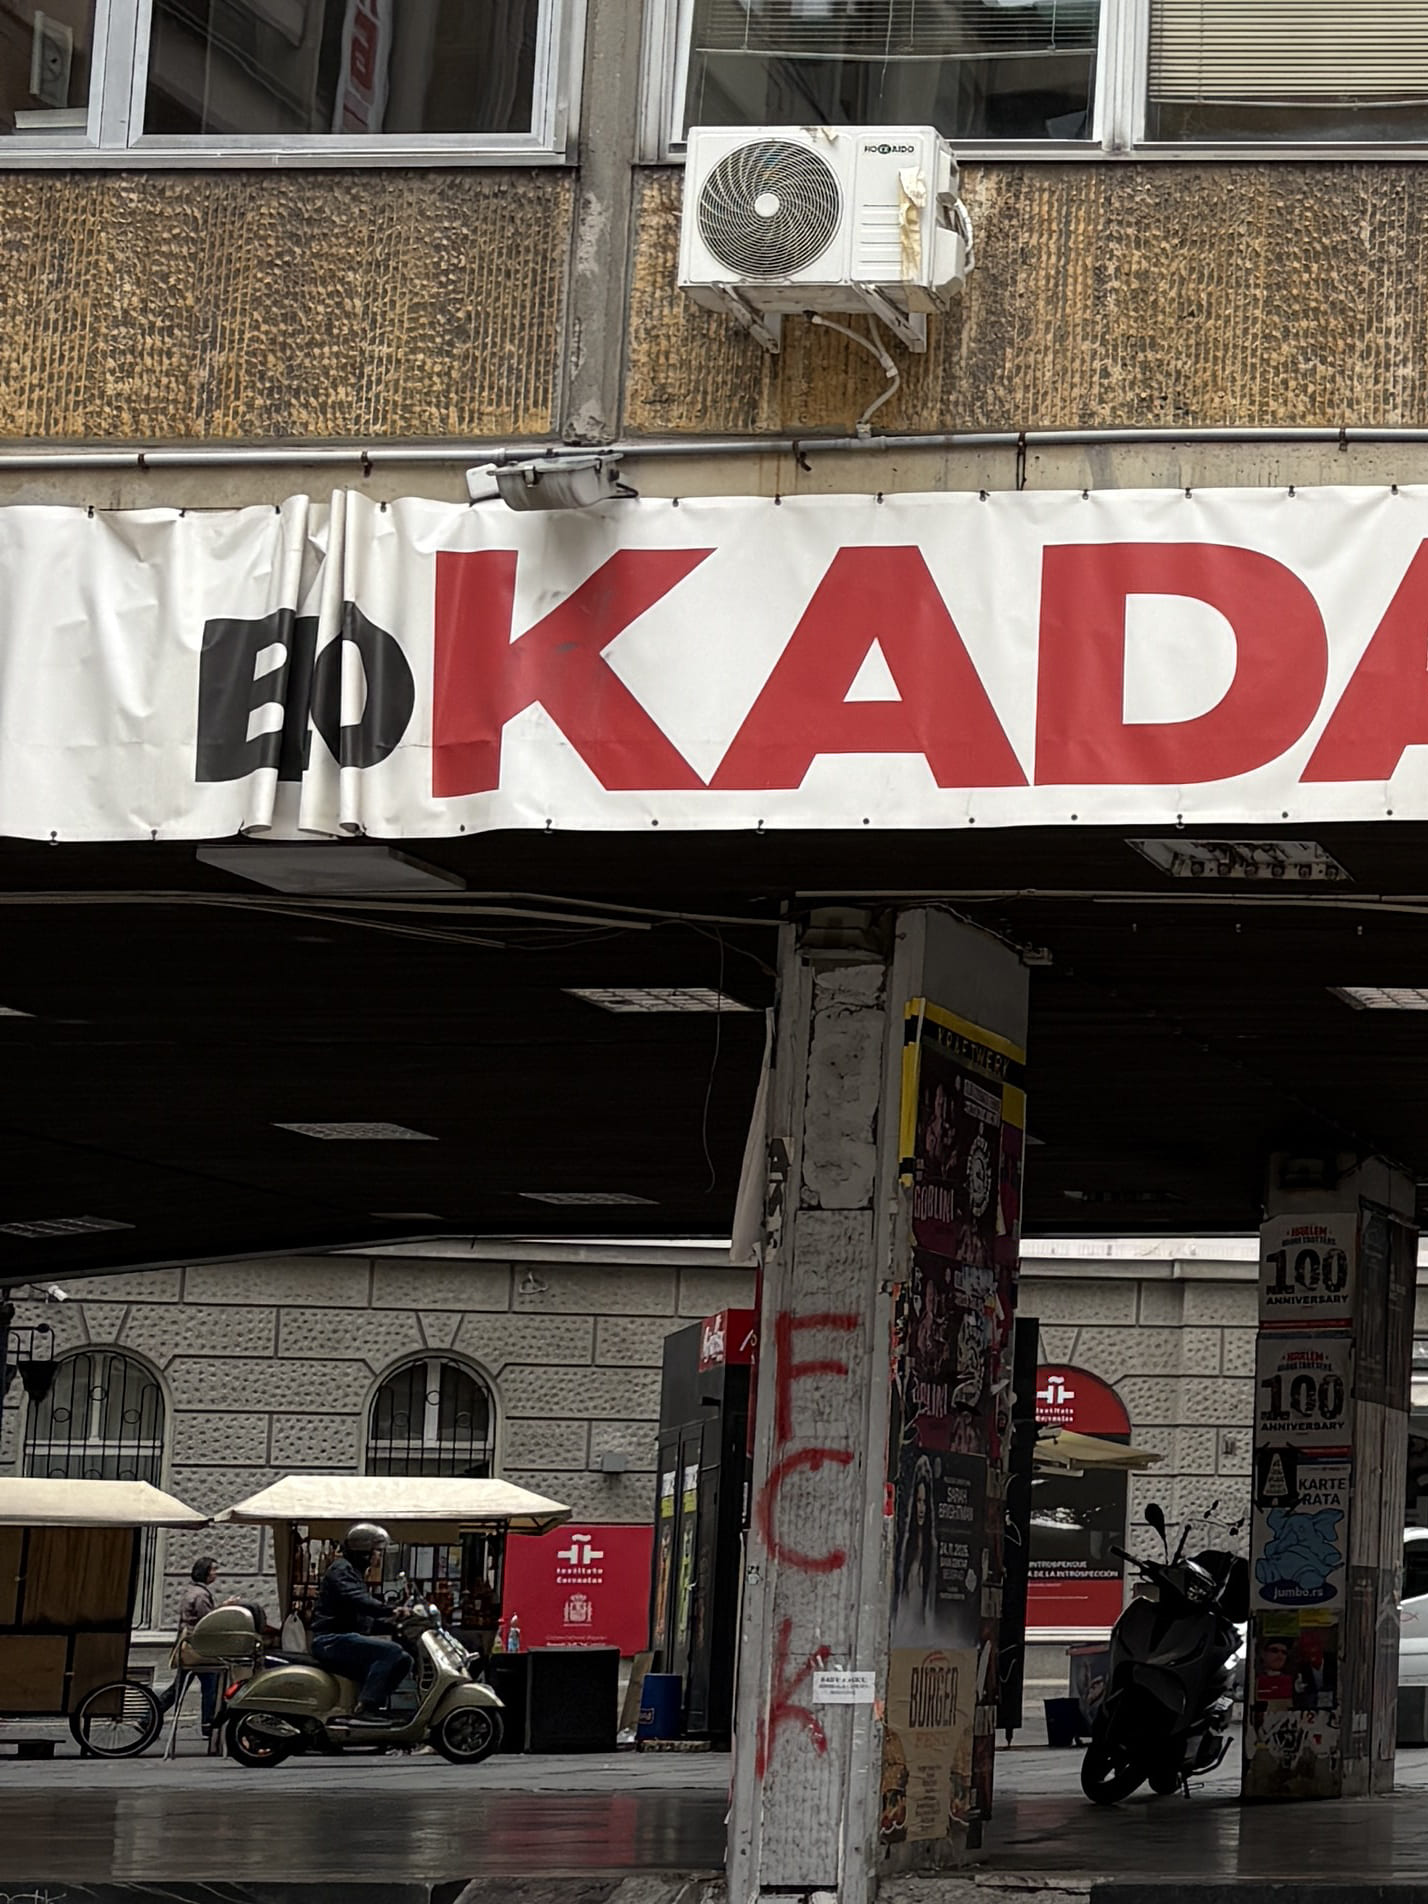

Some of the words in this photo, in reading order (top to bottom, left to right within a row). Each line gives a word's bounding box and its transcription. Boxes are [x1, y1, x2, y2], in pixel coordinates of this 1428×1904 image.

[1265, 1247, 1348, 1295] 100
[1265, 1294, 1349, 1306] ANNIVERSARY
[1260, 1374, 1345, 1421] 100
[1260, 1421, 1346, 1432] ANNIVERSARY
[1298, 1478, 1347, 1491] KARTE
[1302, 1493, 1341, 1505] RATA
[1271, 1581, 1325, 1600] jumbo.rs
[909, 1666, 959, 1728] BURGER
